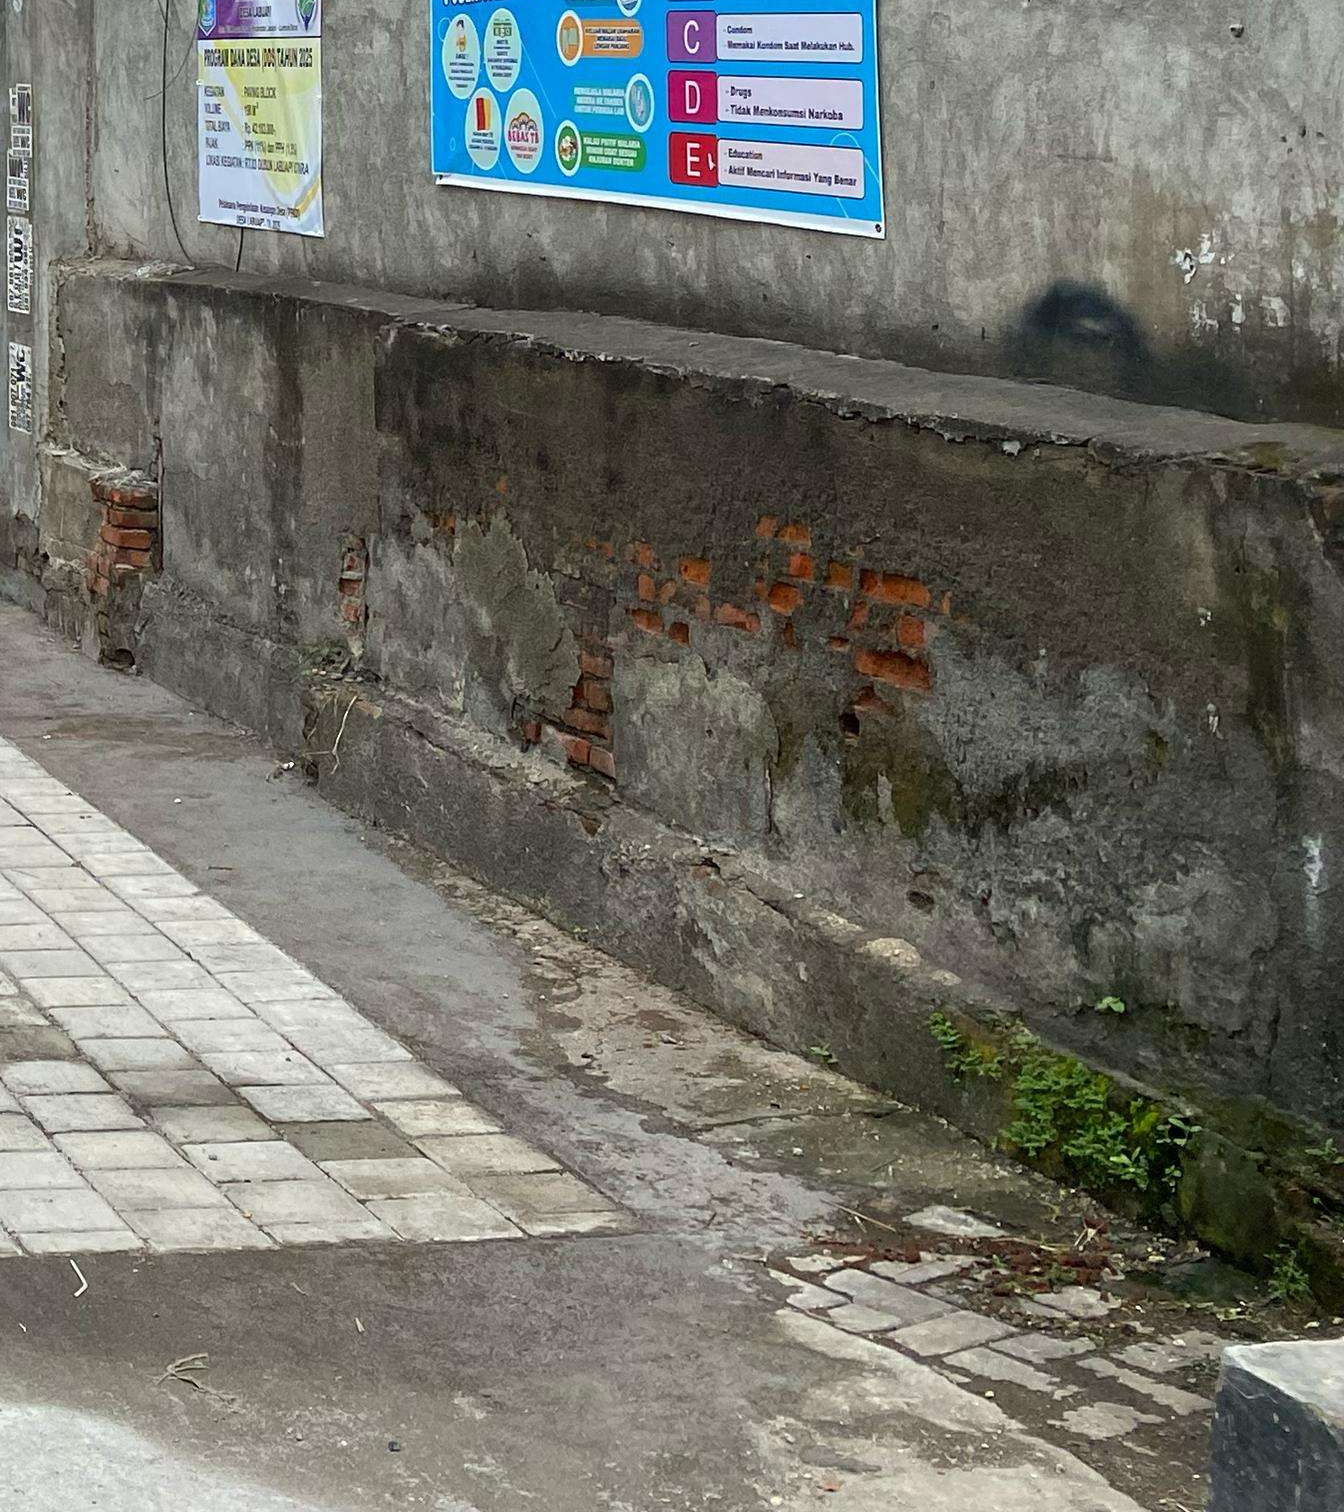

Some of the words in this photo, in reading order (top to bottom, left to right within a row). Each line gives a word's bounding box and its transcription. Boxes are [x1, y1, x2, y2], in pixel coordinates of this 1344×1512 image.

[683, 20, 700, 54] C
[684, 80, 701, 114] D
[730, 86, 752, 99] Drugs
[730, 104, 751, 116] Tidak
[808, 108, 844, 121] Narkoba
[686, 142, 701, 177] E
[727, 148, 763, 160] Education
[727, 164, 745, 176] Aktif
[776, 169, 812, 182] Informasi
[813, 172, 833, 186] Yang
